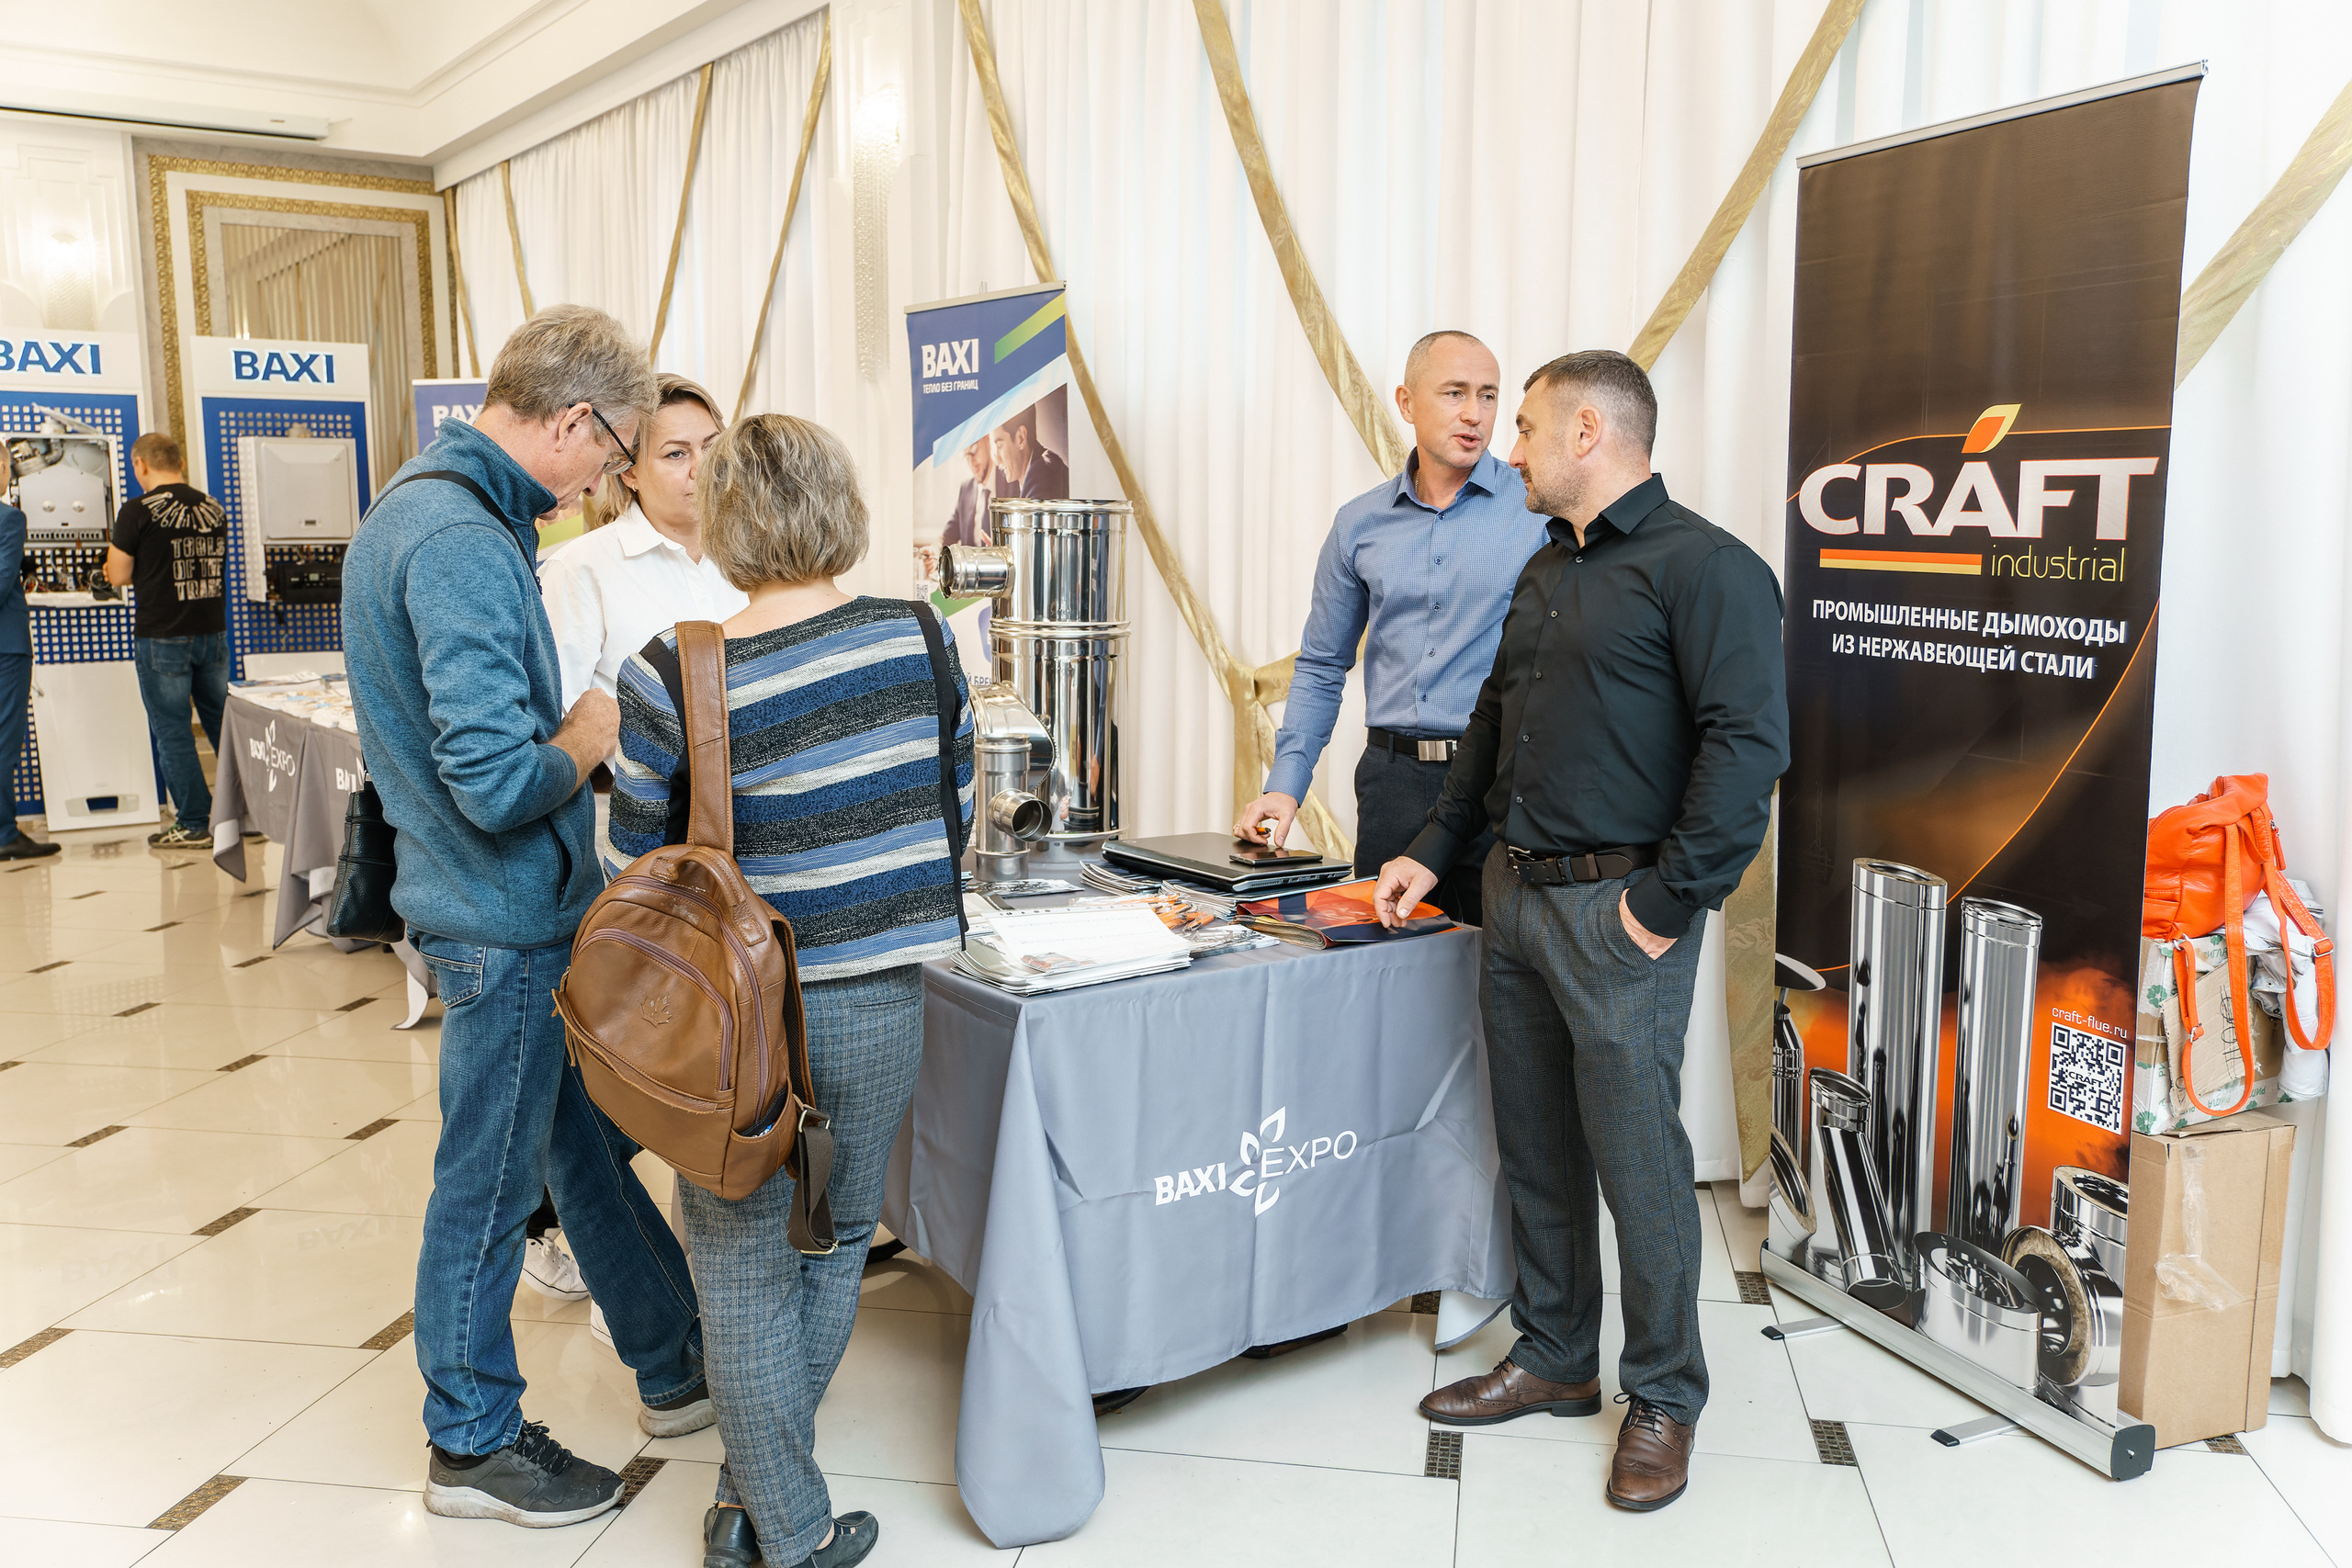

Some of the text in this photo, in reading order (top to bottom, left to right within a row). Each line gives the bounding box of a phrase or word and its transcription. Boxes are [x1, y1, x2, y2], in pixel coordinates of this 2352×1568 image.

[0, 340, 101, 374] BAXI
[232, 350, 334, 383] BAXI
[922, 338, 978, 378] BAXI
[922, 378, 978, 394] ТЕПЛО БЕЗ ГРАНИЦ
[432, 404, 484, 428] BAX
[1798, 457, 2160, 540] CRAFT
[170, 536, 225, 558] TOOLS
[1991, 545, 2125, 582] industrial
[173, 558, 223, 581] OF THE
[175, 578, 222, 602] TRADE
[1812, 599, 2126, 647] ПРОМЫШЛЕННЫЕ ДЫМОХОДЫ
[1832, 634, 2095, 680] ИЗ НЕРЖАВЕЮЩЕЙ СТАЛИ
[2052, 1007, 2127, 1039] craft-flue.ru
[2068, 1071, 2103, 1088] CRAFT
[1154, 1130, 1358, 1206] BAXI EXPO
